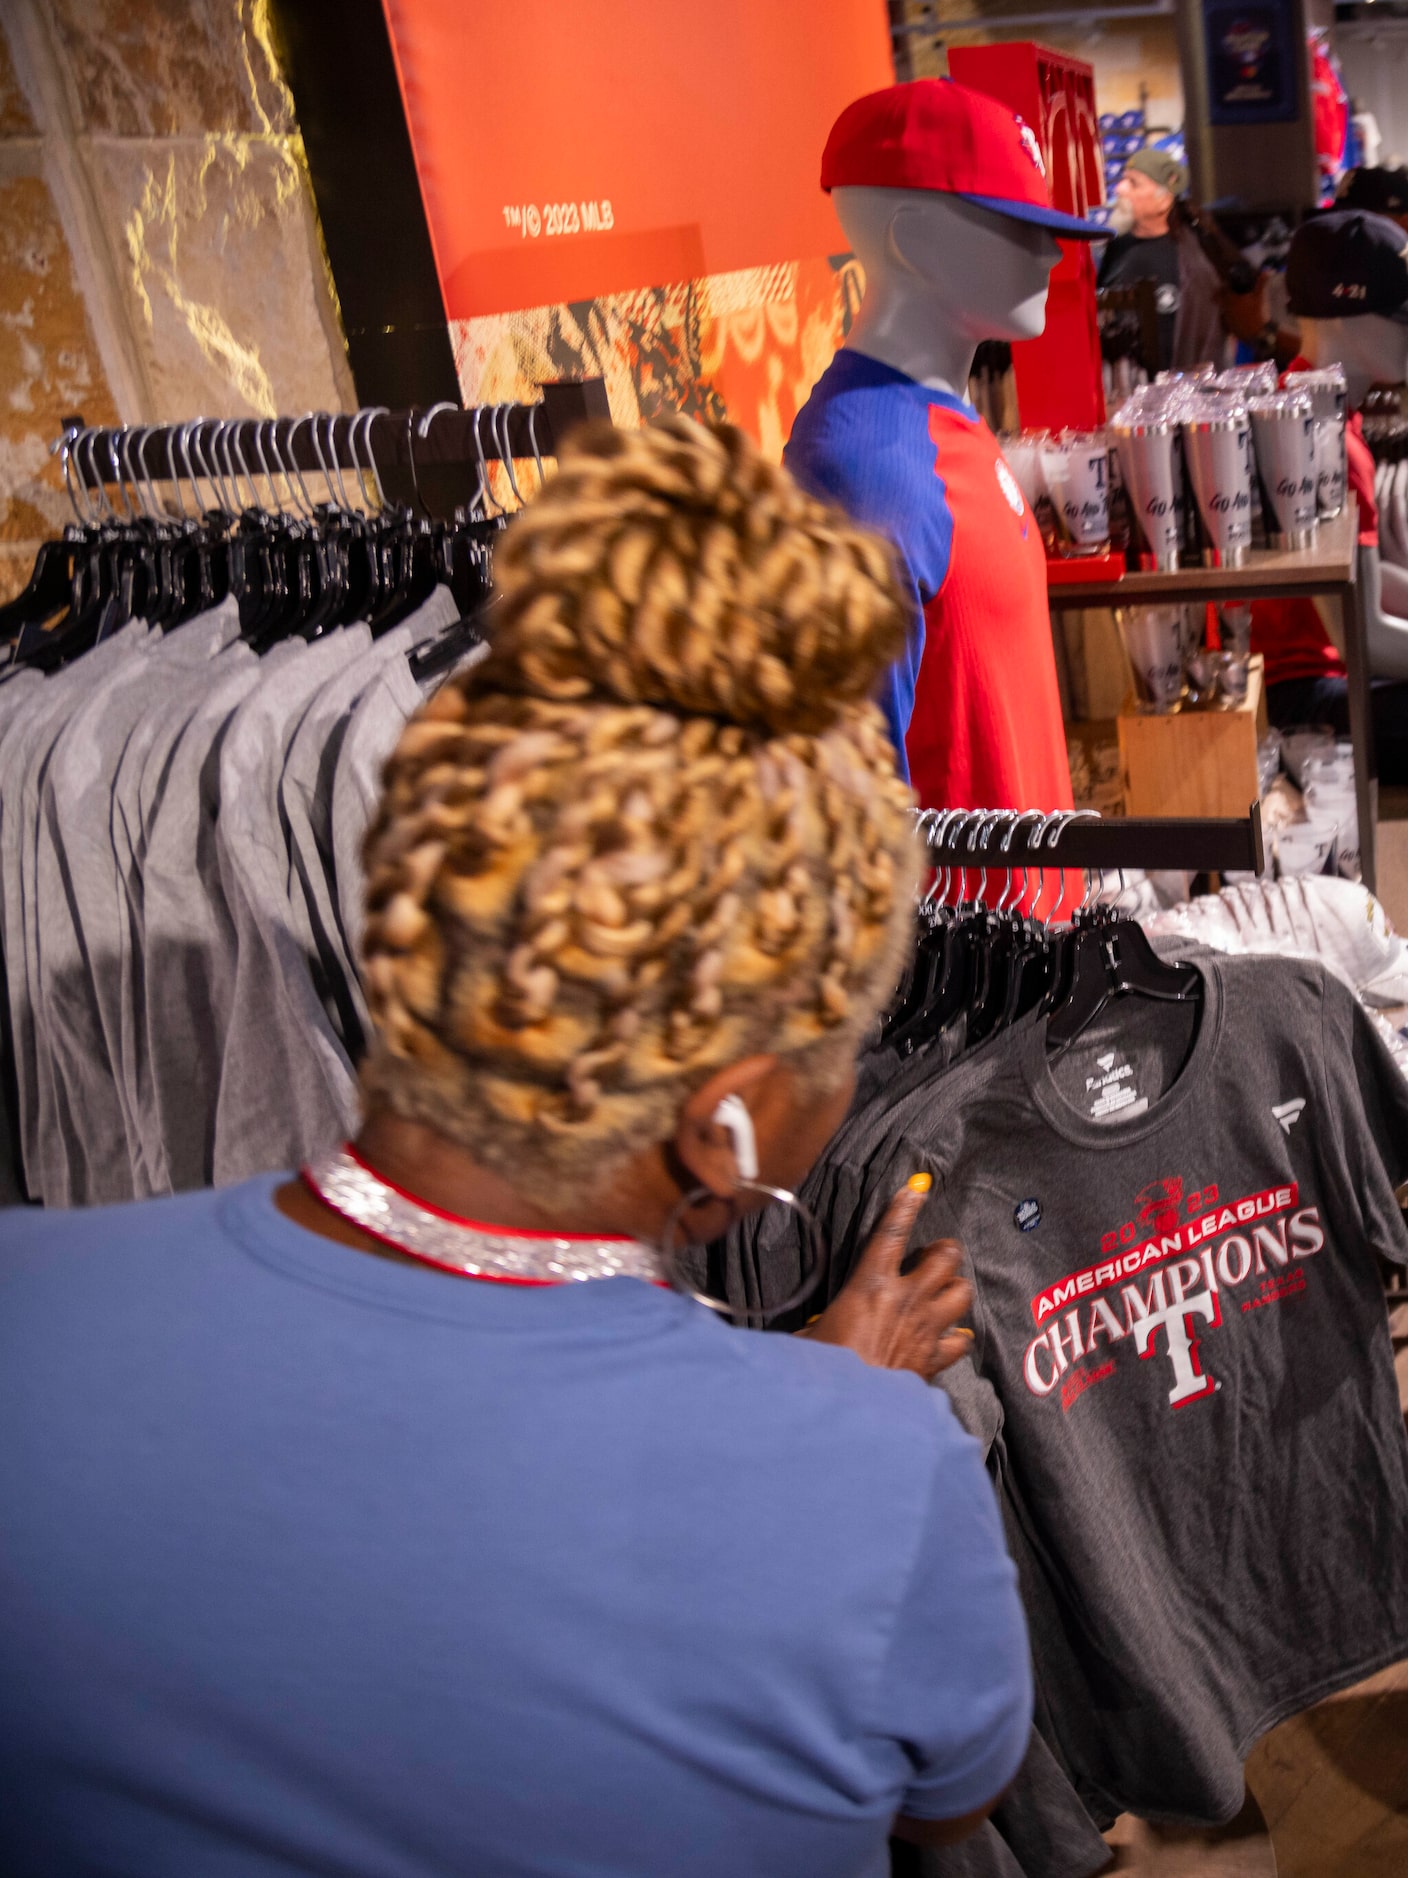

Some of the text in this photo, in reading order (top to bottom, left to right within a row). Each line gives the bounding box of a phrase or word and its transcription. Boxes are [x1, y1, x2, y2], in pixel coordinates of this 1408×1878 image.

[580, 199, 614, 232] MLB
[1037, 1187, 1292, 1320] AMERICAN LEAGUE
[1101, 1183, 1219, 1253] 20 23
[1023, 1206, 1325, 1397] CHAMPIONS
[1133, 1288, 1223, 1411] T
